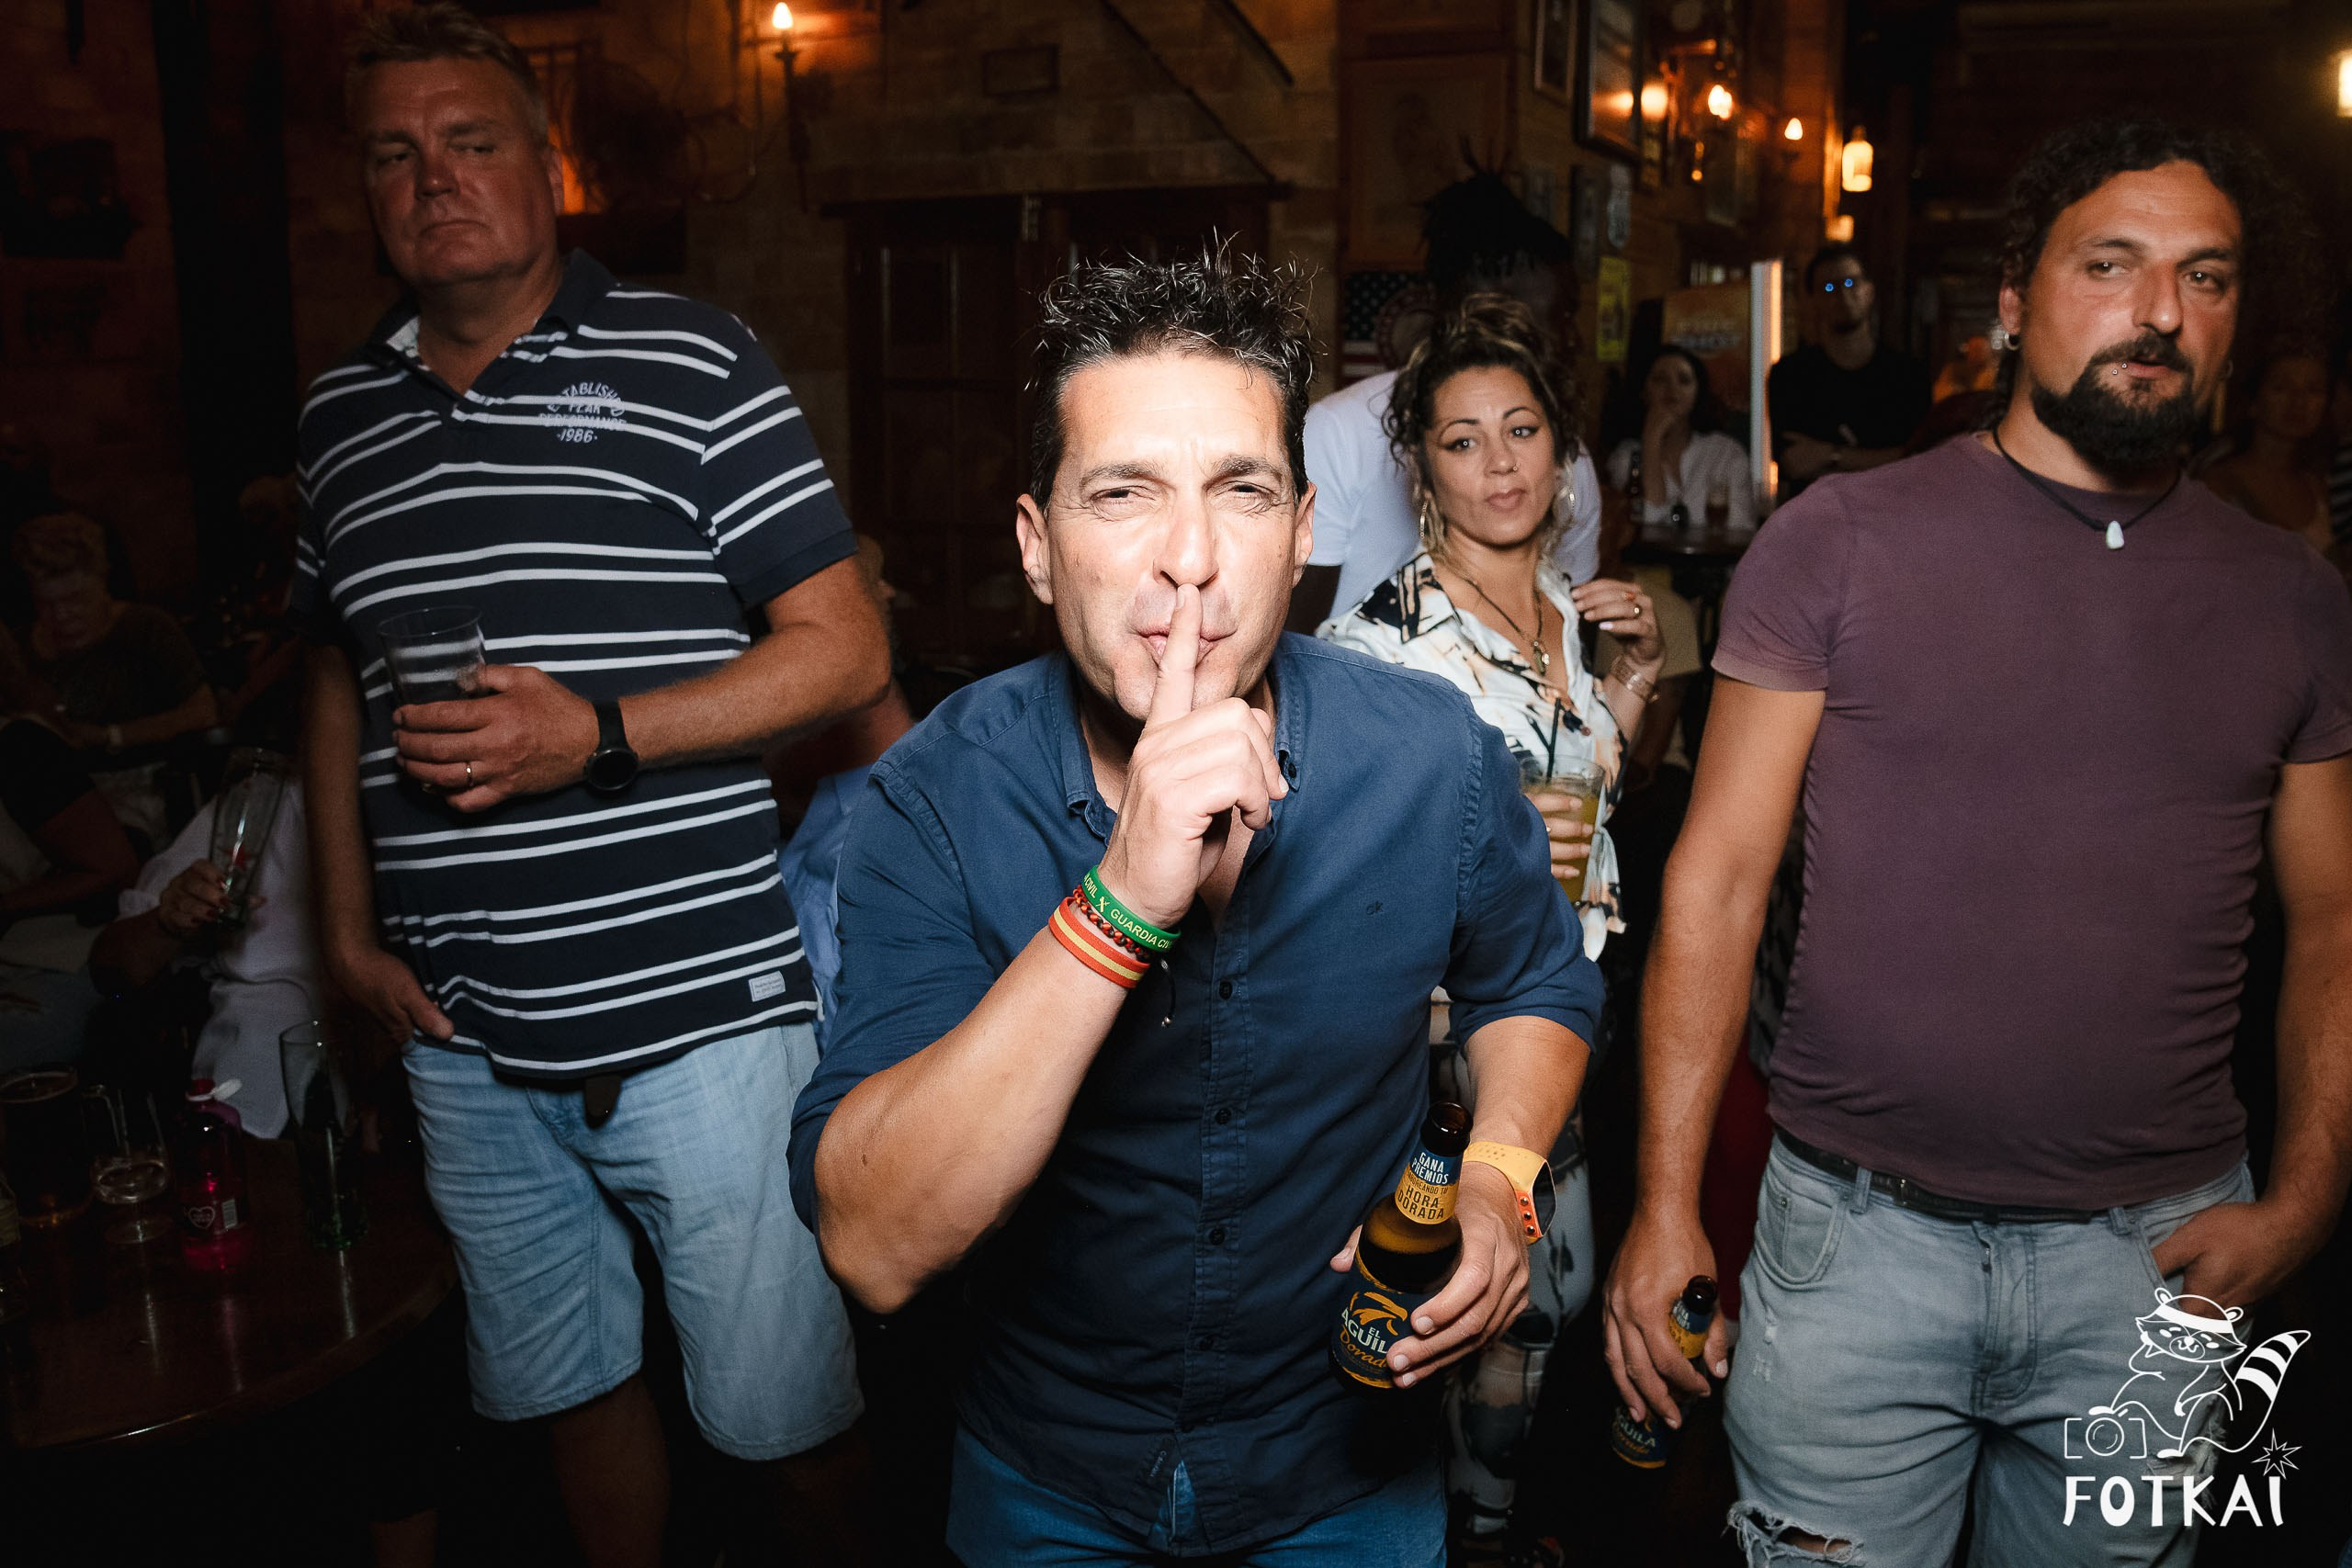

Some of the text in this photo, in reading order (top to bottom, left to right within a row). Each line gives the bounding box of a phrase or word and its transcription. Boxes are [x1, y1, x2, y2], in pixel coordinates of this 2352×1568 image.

[1110, 908, 1158, 945] GUARDIA
[1411, 1157, 1450, 1185] PREMIOS
[1419, 1151, 1445, 1173] GANA
[1397, 1189, 1444, 1220] DORADA
[1406, 1184, 1440, 1208] HORA
[1341, 1306, 1388, 1354] AGUIL
[1368, 1325, 1381, 1339] EL
[1340, 1324, 1388, 1368] Dorad
